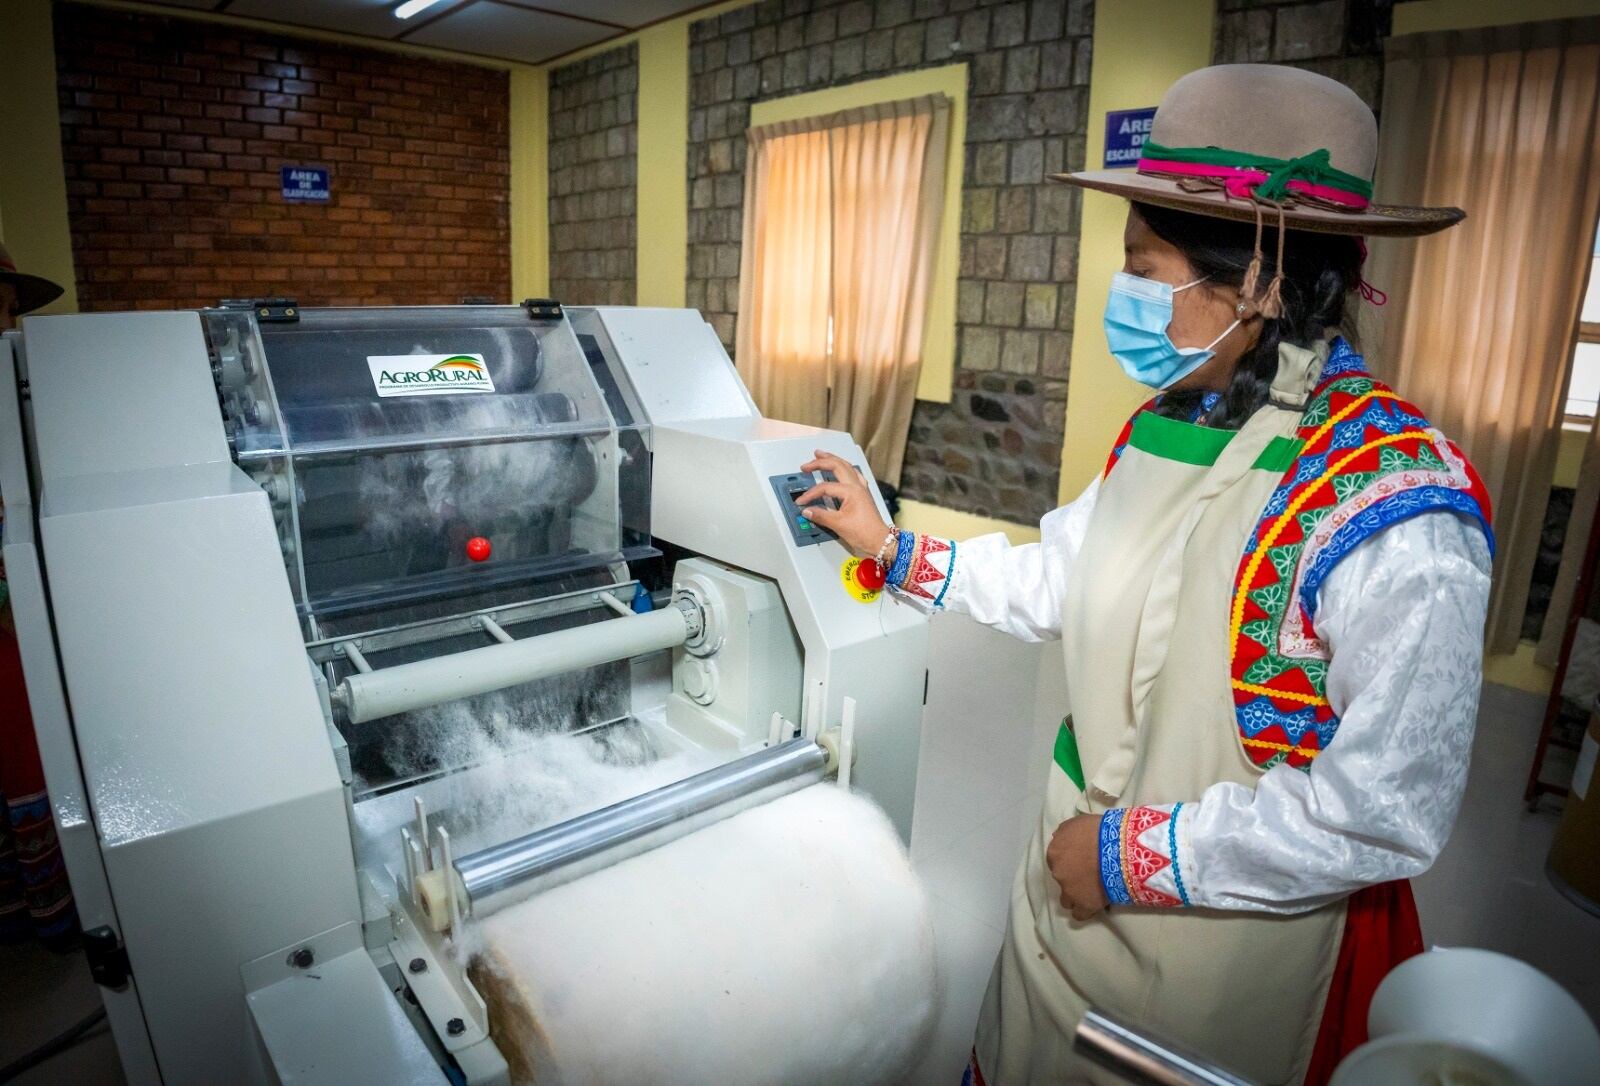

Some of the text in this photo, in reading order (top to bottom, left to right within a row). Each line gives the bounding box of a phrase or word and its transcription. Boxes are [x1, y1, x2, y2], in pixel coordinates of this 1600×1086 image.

[1118, 117, 1153, 135] ÁRE
[1106, 148, 1142, 162] ESCARM
[298, 181, 312, 190] DE
[845, 559, 860, 581] EMERG
